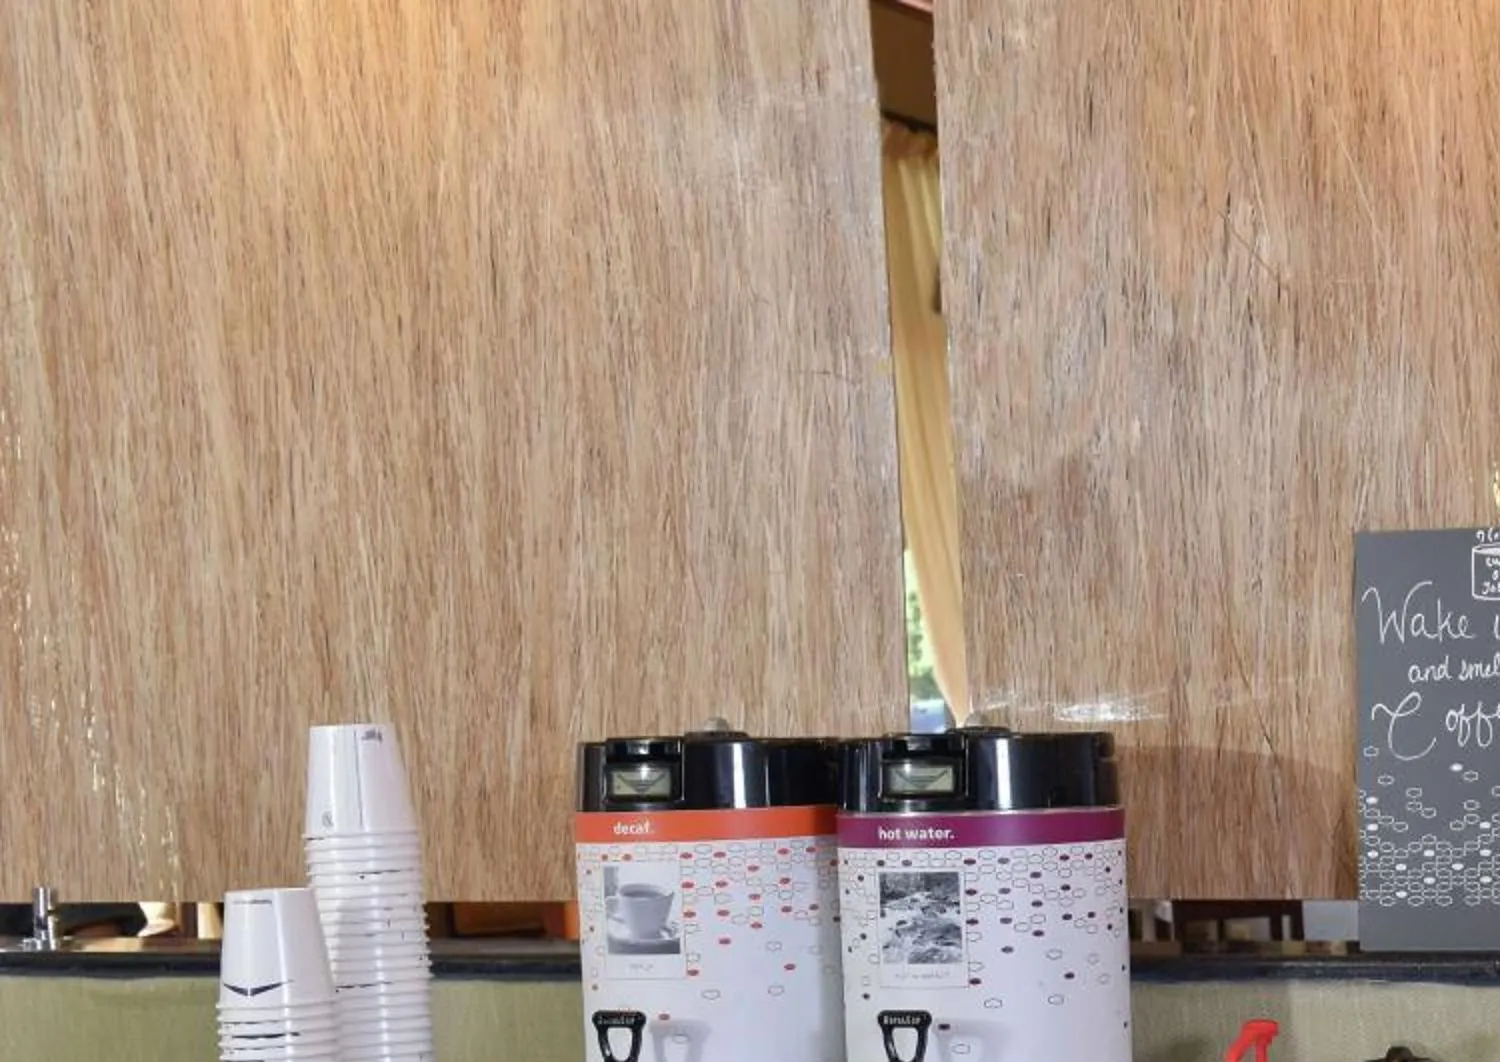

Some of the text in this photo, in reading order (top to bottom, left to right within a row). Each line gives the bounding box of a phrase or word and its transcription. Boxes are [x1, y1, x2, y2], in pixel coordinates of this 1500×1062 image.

[1361, 580, 1477, 644] Wake
[1408, 655, 1452, 683] and
[612, 819, 655, 836] decaf.
[877, 825, 956, 840] hot water.
